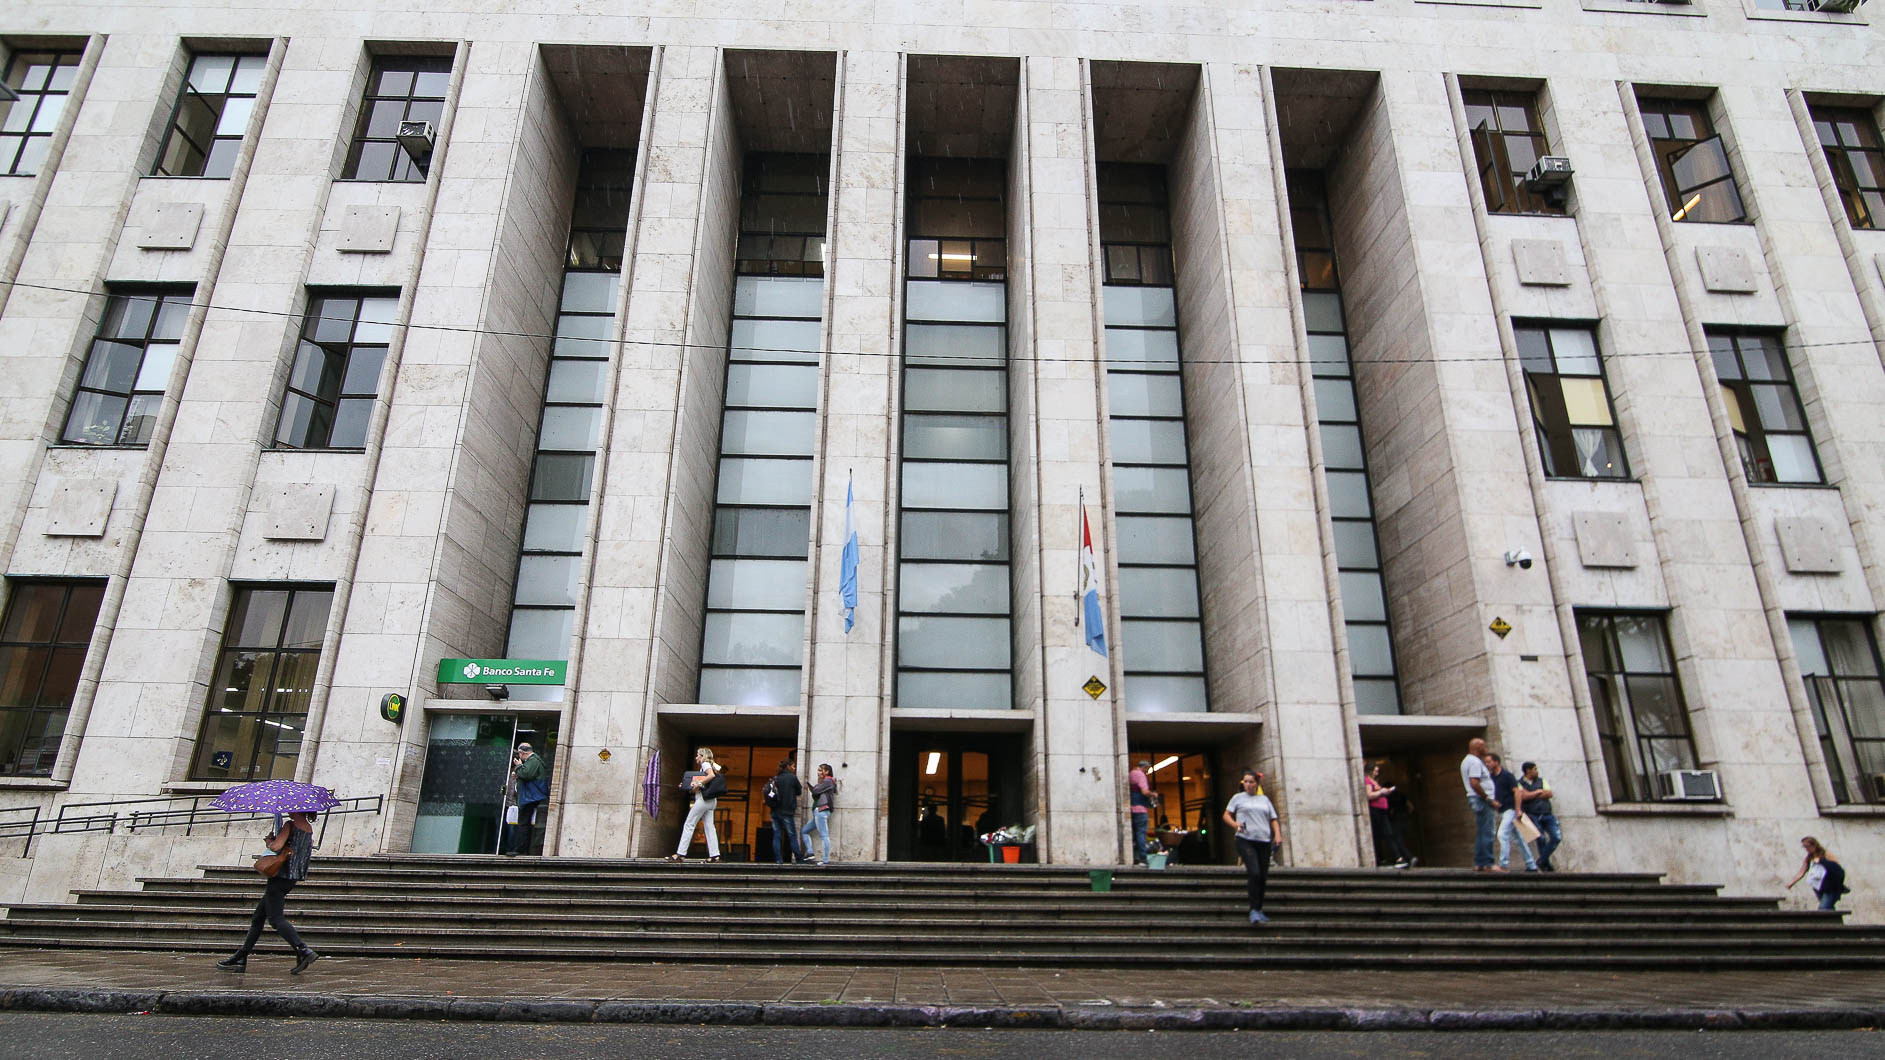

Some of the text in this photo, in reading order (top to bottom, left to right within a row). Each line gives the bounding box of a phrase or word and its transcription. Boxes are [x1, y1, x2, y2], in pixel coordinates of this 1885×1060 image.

[482, 666, 555, 677] Banco Santa Fe
